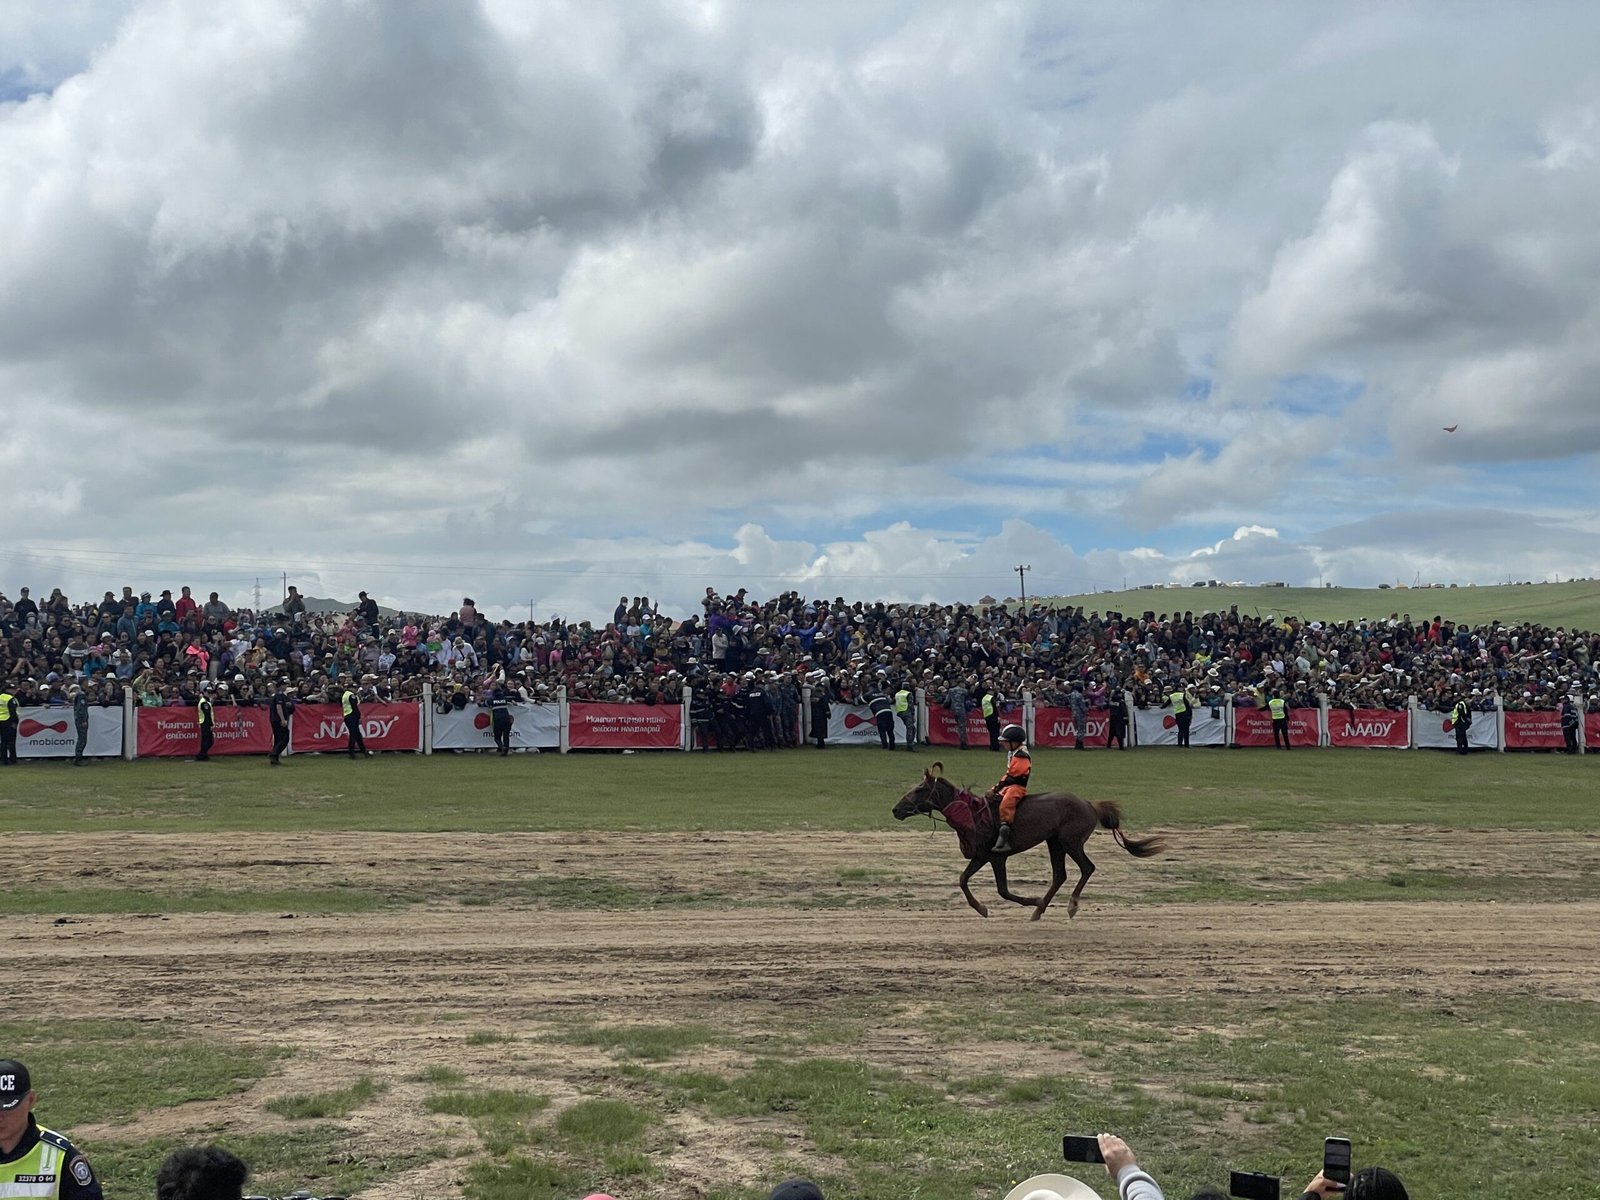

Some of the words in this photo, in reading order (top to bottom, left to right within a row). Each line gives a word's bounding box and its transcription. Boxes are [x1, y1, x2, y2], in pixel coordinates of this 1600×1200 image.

[1049, 718, 1109, 737] NADY
[1341, 719, 1396, 737] NAADY
[29, 738, 75, 746] mobicom
[0, 1075, 15, 1091] CE
